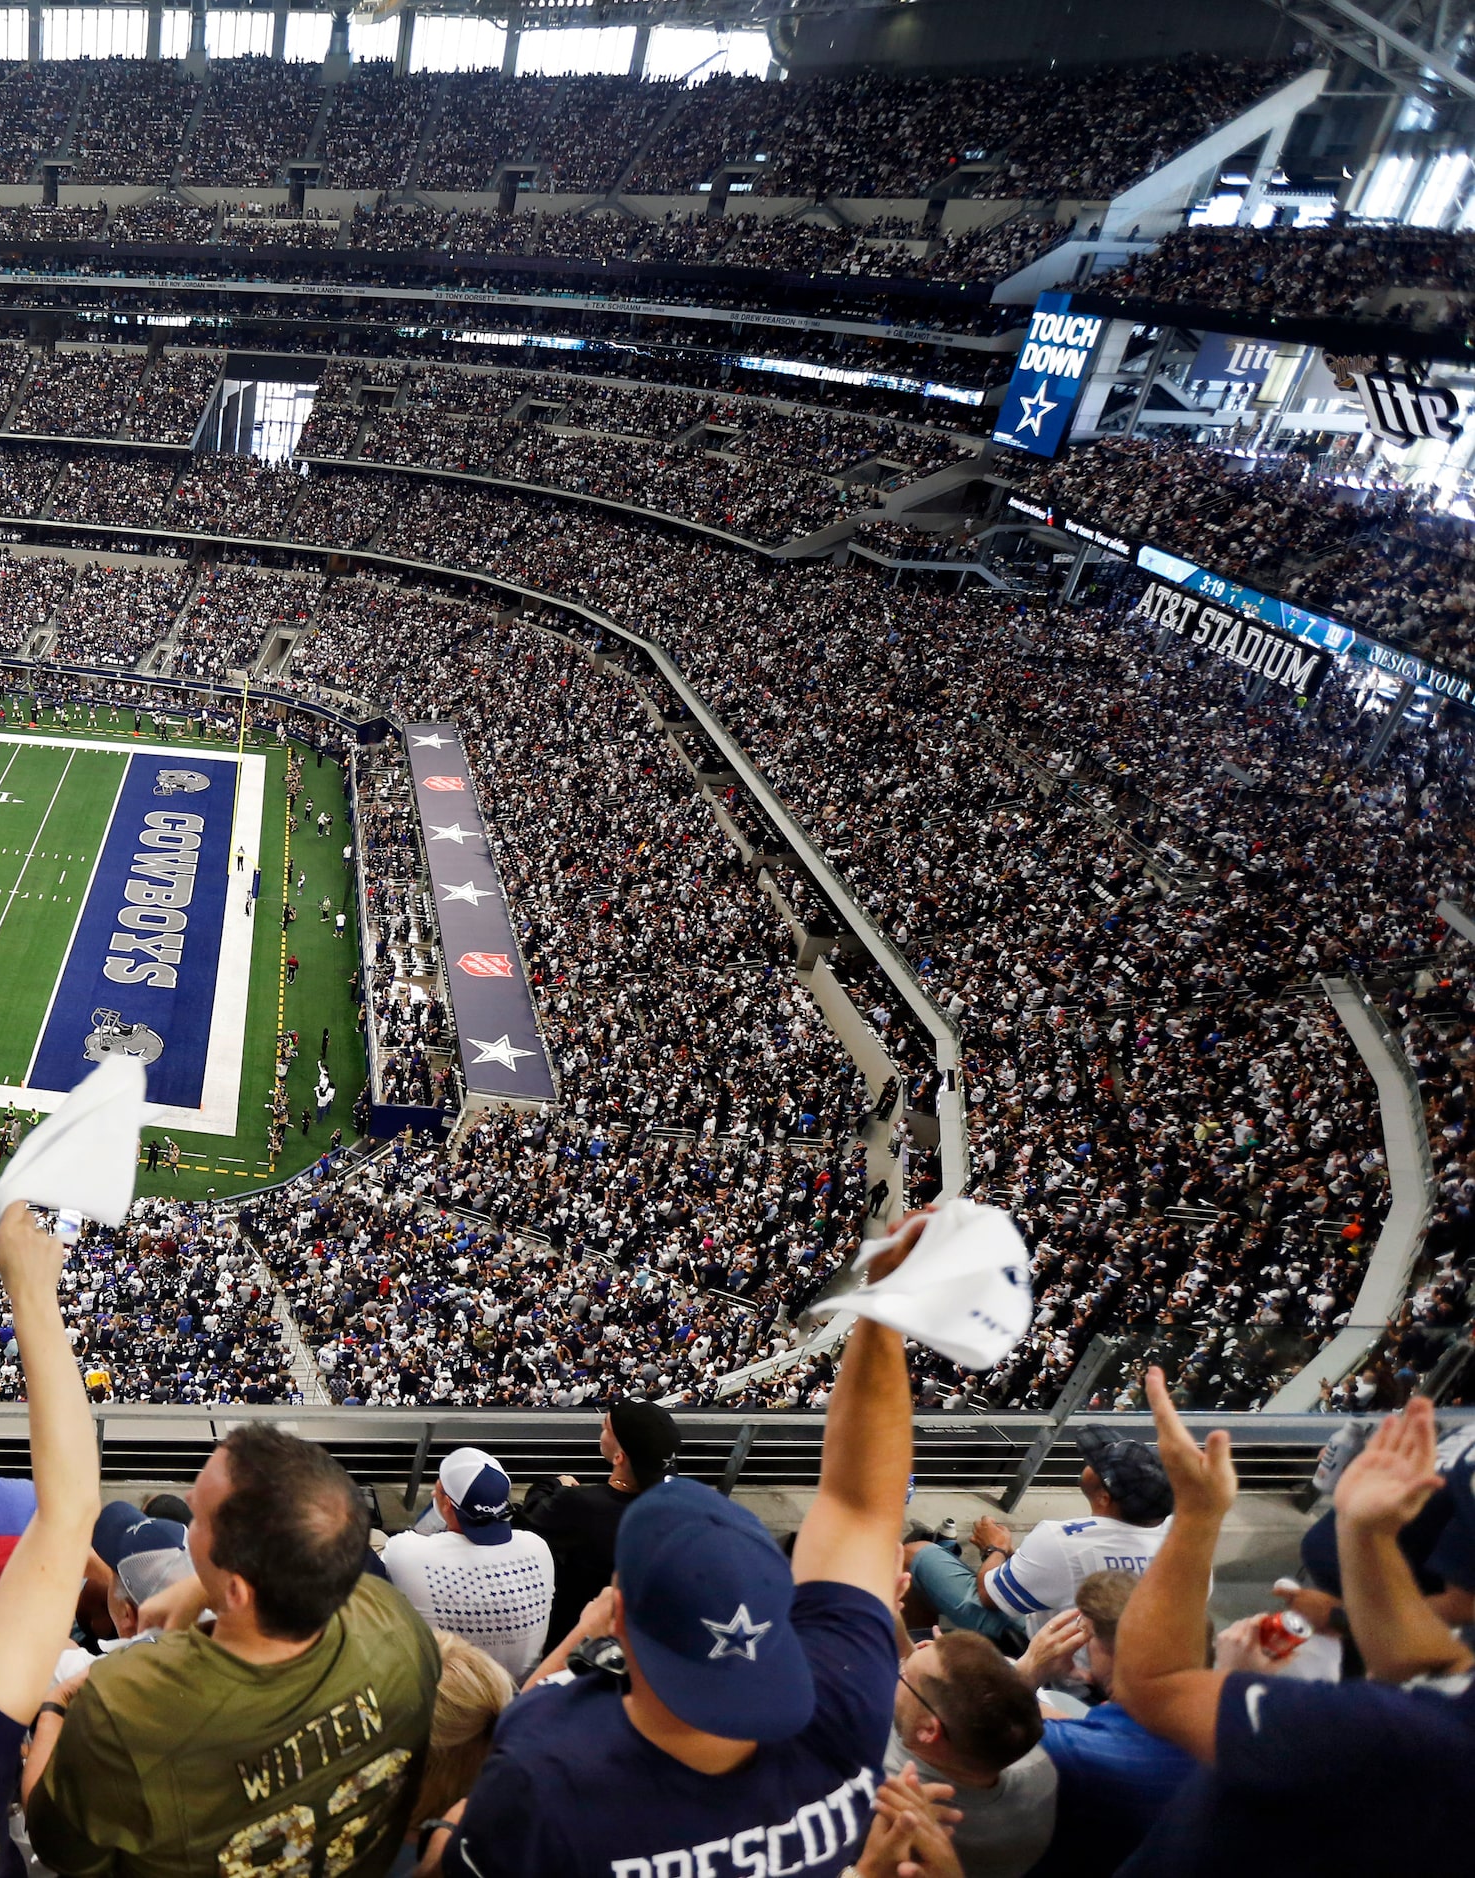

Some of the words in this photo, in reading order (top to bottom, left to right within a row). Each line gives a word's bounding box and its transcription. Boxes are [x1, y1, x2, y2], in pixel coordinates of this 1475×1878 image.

[464, 294, 496, 302] DORSETT
[592, 302, 606, 310] TEX
[741, 314, 761, 322] DREW
[763, 316, 797, 326] PEARSON
[1029, 312, 1102, 349] TOUCH
[1019, 342, 1088, 379] DOWN
[1348, 372, 1463, 448] Lite
[1065, 519, 1079, 533] Your
[1095, 531, 1110, 546] Your
[1199, 575, 1226, 598] 3:19
[1135, 582, 1198, 635] AT&T
[1192, 607, 1320, 694] STADIUM
[1426, 668, 1472, 702] YOUR
[102, 810, 206, 989] COWBOYS
[236, 1684, 383, 1802] WITTEN
